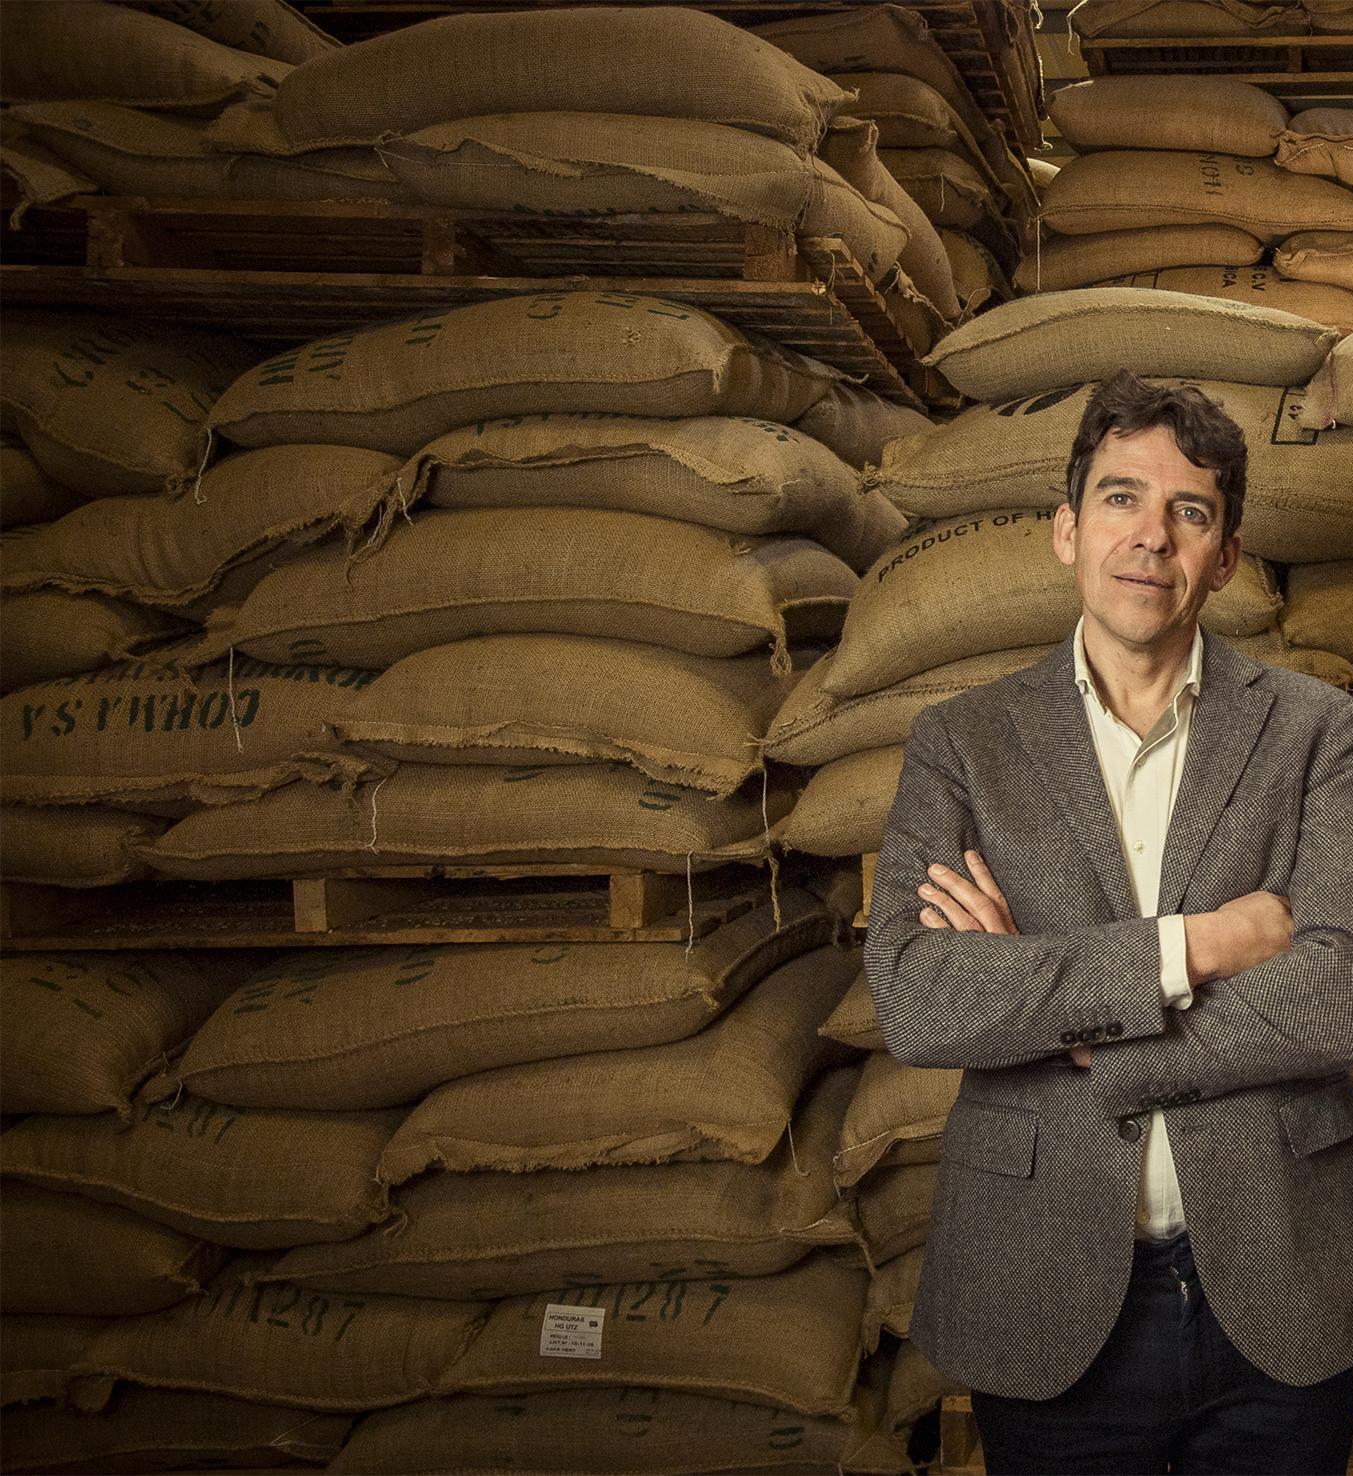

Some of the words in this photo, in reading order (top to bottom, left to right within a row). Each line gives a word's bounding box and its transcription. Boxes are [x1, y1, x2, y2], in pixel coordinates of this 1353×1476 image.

[878, 519, 984, 583] PRODUCT
[993, 511, 1025, 527] OF
[1036, 510, 1057, 521] H
[549, 1314, 585, 1323] HONDURAS
[565, 1323, 578, 1331] UTZ
